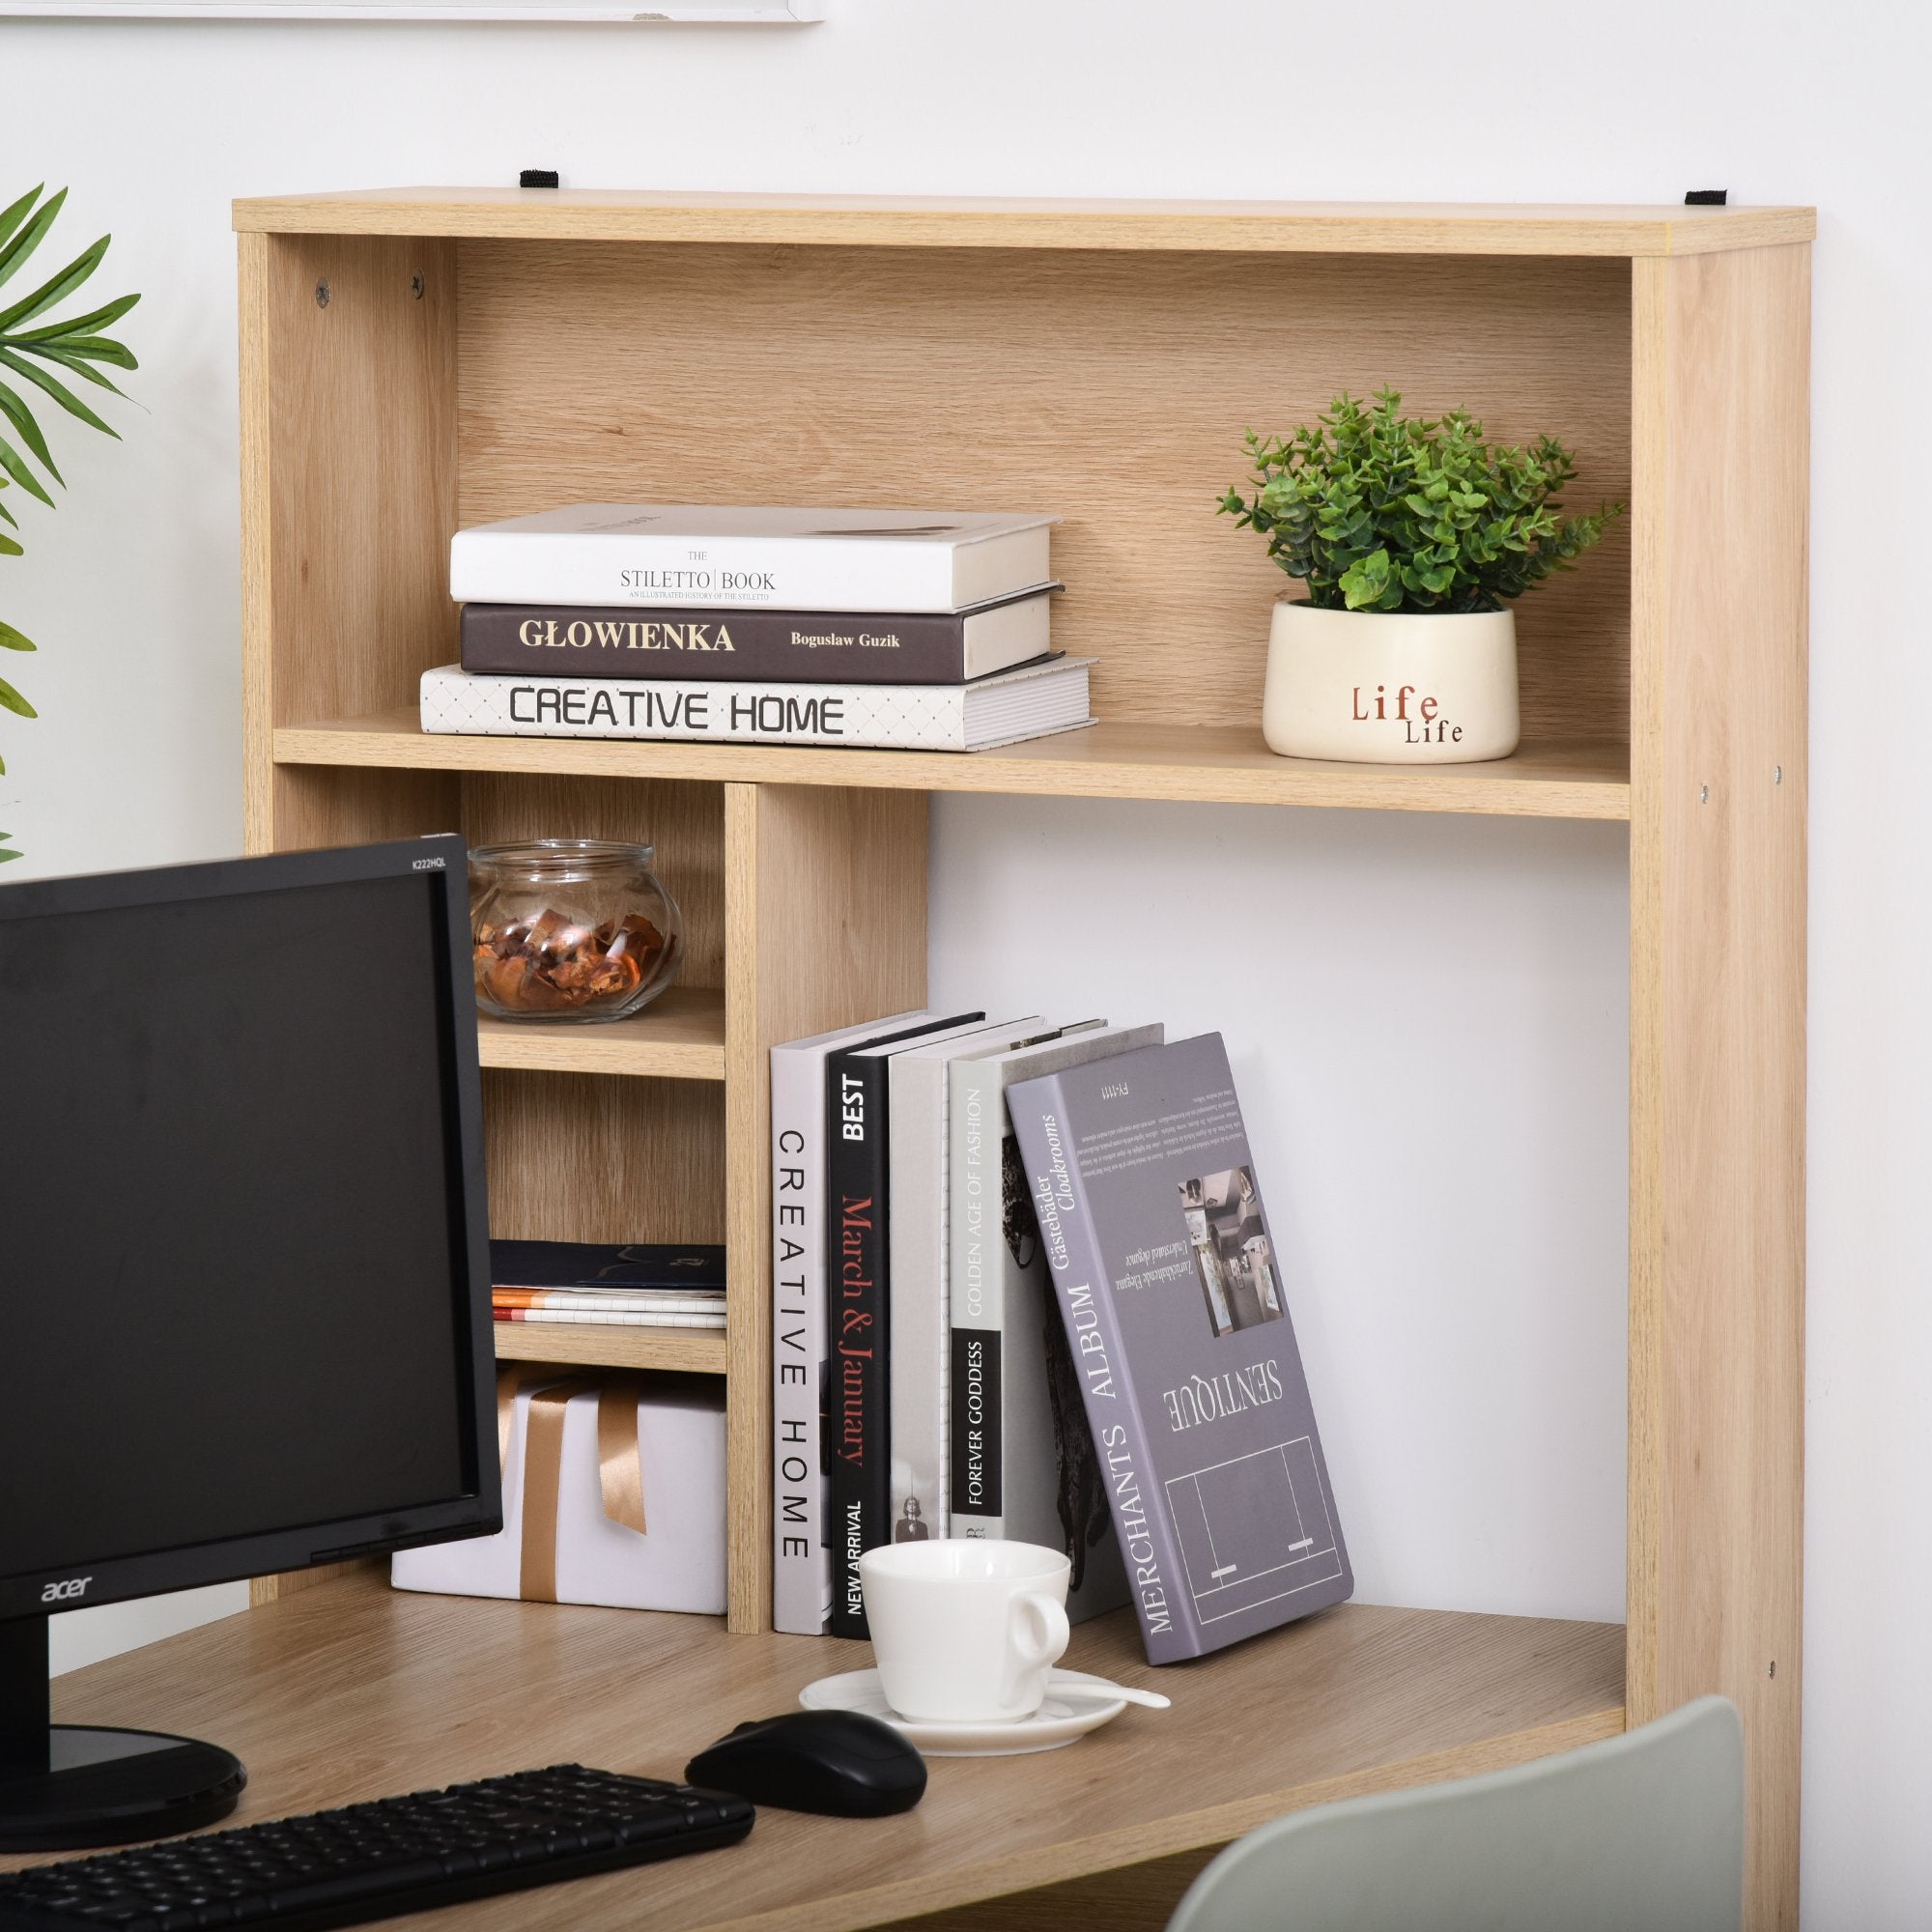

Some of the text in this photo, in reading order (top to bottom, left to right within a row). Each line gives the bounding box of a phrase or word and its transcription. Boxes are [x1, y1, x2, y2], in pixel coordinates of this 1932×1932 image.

[620, 569, 777, 590] STILETTO BOOK
[687, 551, 708, 561] THE
[518, 618, 736, 652] GŁOWIENKA
[859, 634, 900, 648] Guzik
[510, 687, 844, 735] CREATIVE HOME
[1352, 685, 1438, 721] Life
[1405, 720, 1463, 743] Life
[412, 857, 446, 870] K222HQL
[841, 1072, 864, 1141] BEST
[1101, 1082, 1129, 1100] FY-1111
[1042, 1114, 1075, 1211] Cloakrooms
[966, 1089, 981, 1316] GOLDEN AGE OF FASHION
[1036, 1177, 1069, 1270] Gästebäder
[1151, 1240, 1188, 1264] Understated
[779, 1129, 809, 1558] CREATIVE HOME
[838, 1195, 873, 1467] March & January
[968, 1341, 982, 1505] FOREVER GODDESS
[1163, 1359, 1283, 1433] SENTIQUE
[1066, 1283, 1173, 1635] MERCHANTS ALBUM
[846, 1500, 862, 1615] NEW ARRIVAL
[41, 1577, 93, 1602] acer
